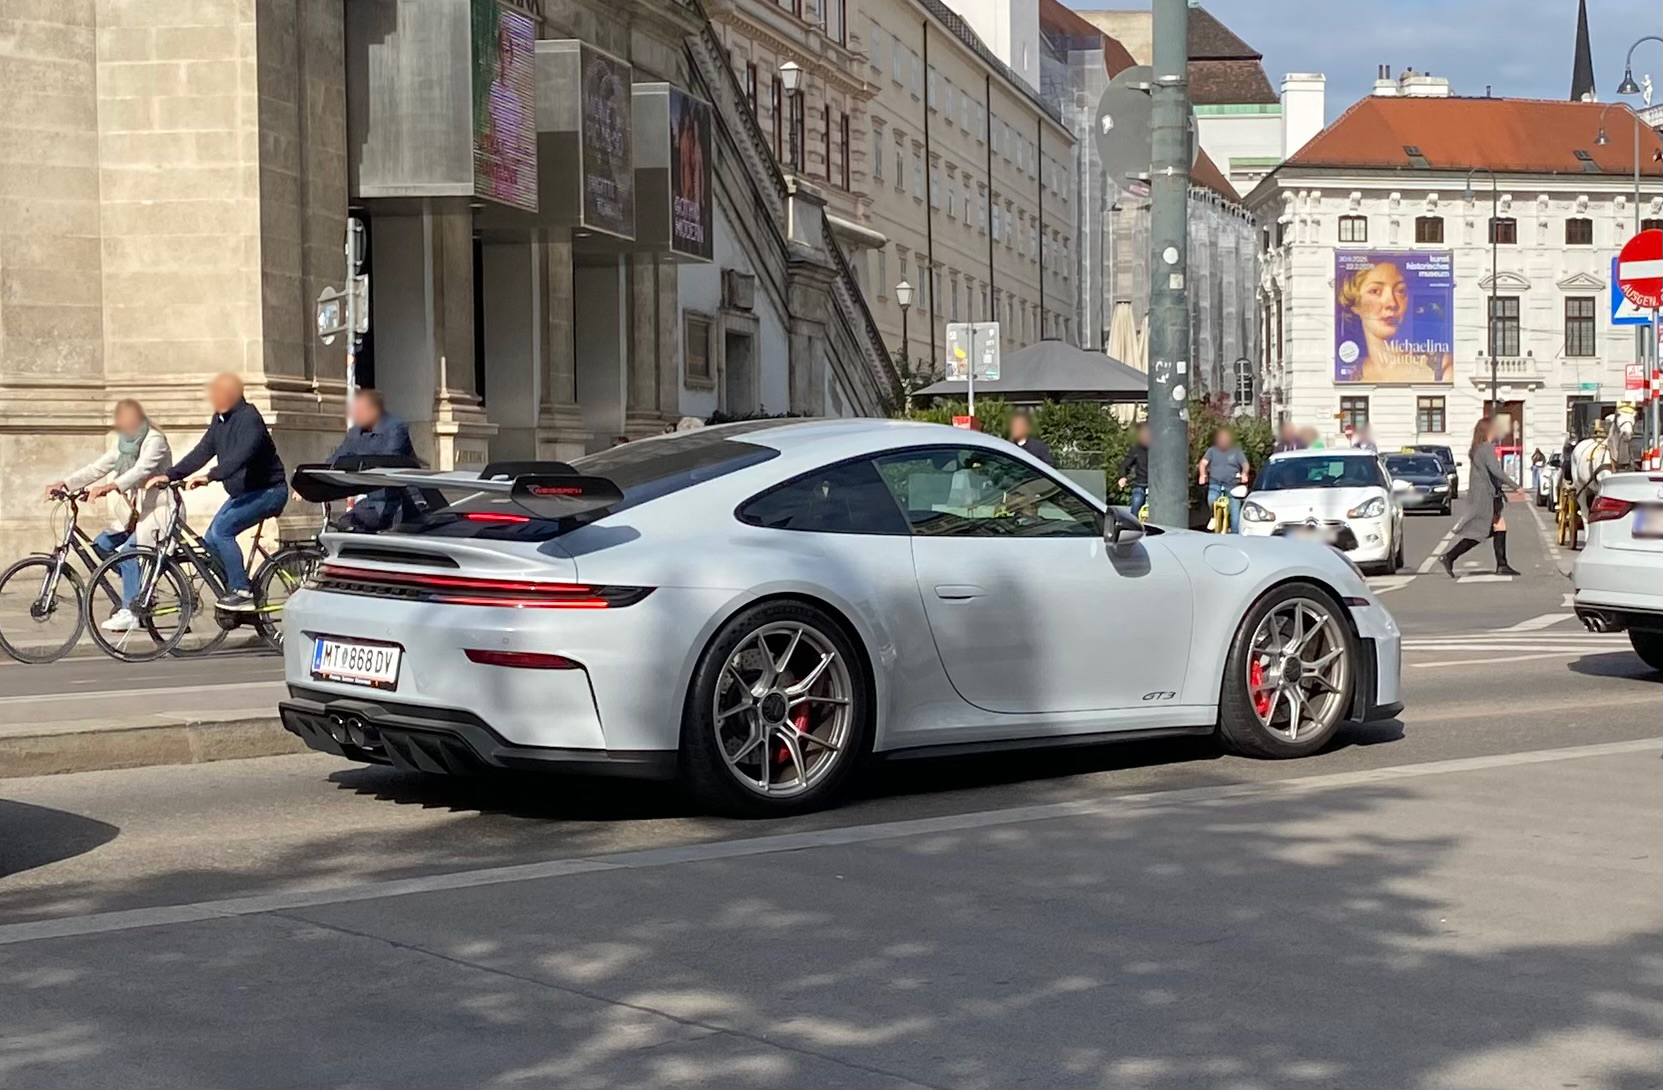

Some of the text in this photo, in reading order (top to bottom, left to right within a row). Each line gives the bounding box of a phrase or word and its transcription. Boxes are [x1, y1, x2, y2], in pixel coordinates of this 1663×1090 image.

[1384, 339, 1449, 353] Michaelina
[323, 644, 341, 667] MT
[1142, 691, 1176, 700] GT3
